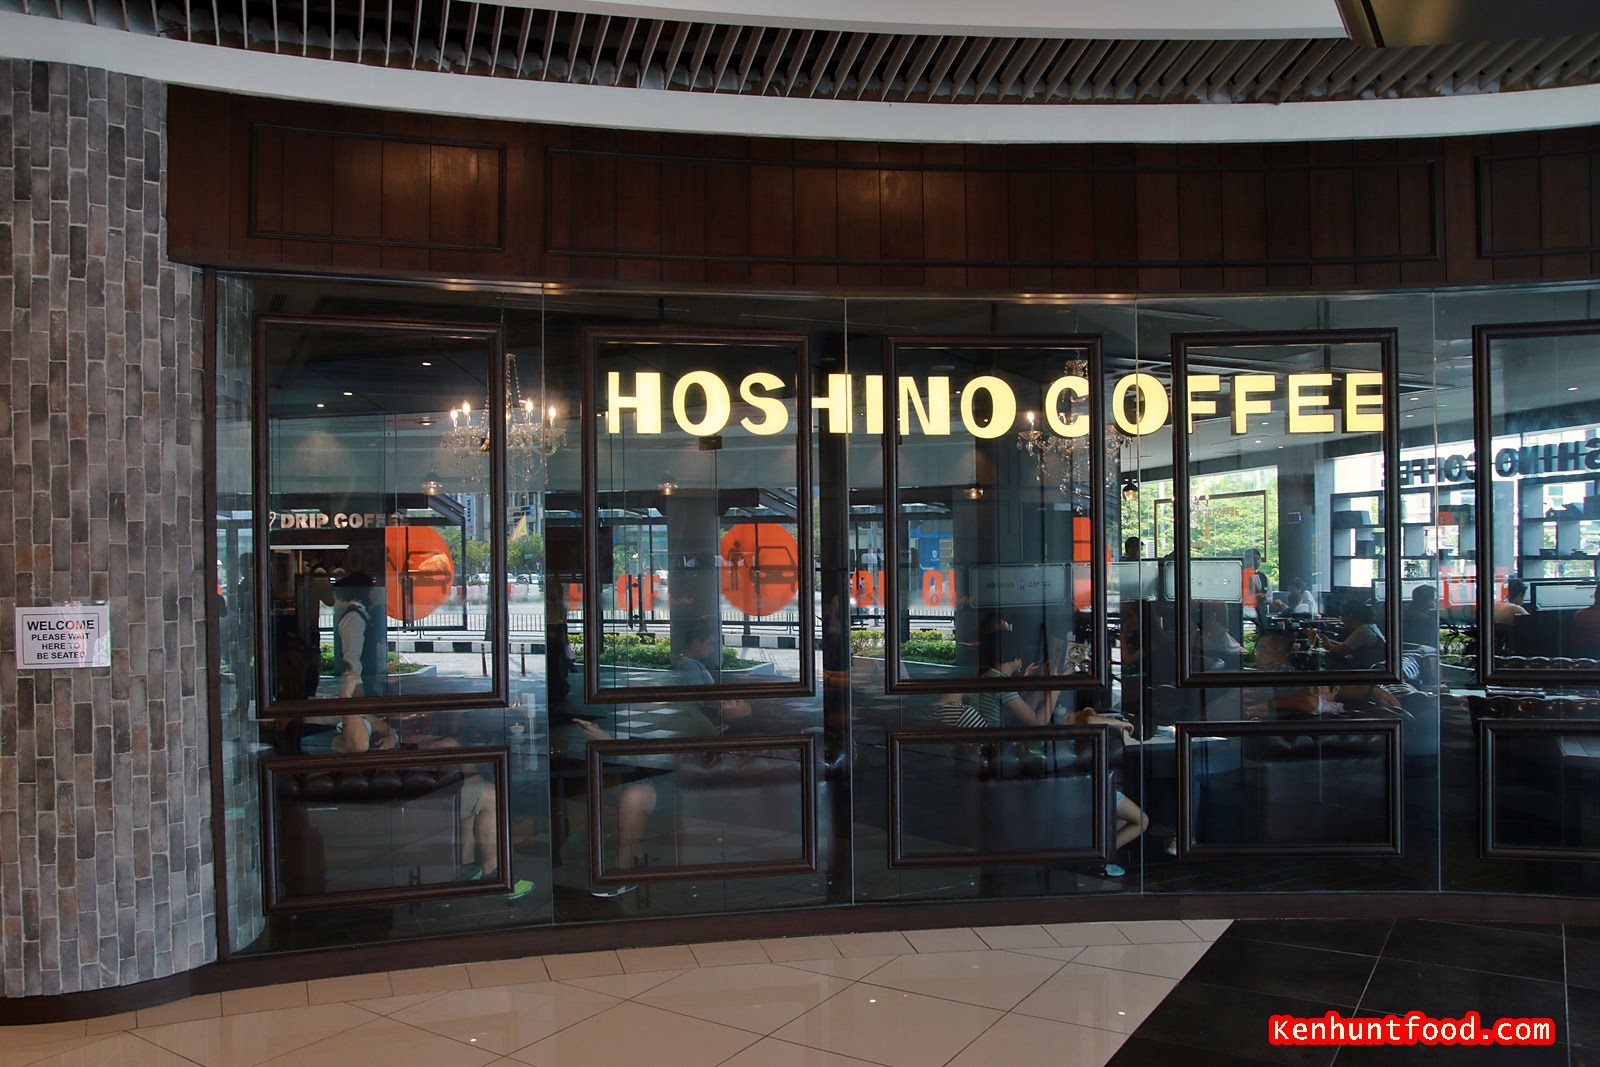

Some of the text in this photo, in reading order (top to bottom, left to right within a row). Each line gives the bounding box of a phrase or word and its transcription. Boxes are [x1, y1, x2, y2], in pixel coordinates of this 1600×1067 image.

[607, 370, 1384, 439] HOSHINO COFFEE
[281, 513, 329, 528] DRIP
[27, 620, 95, 631] WELCOME
[37, 651, 85, 660] BE SEATED
